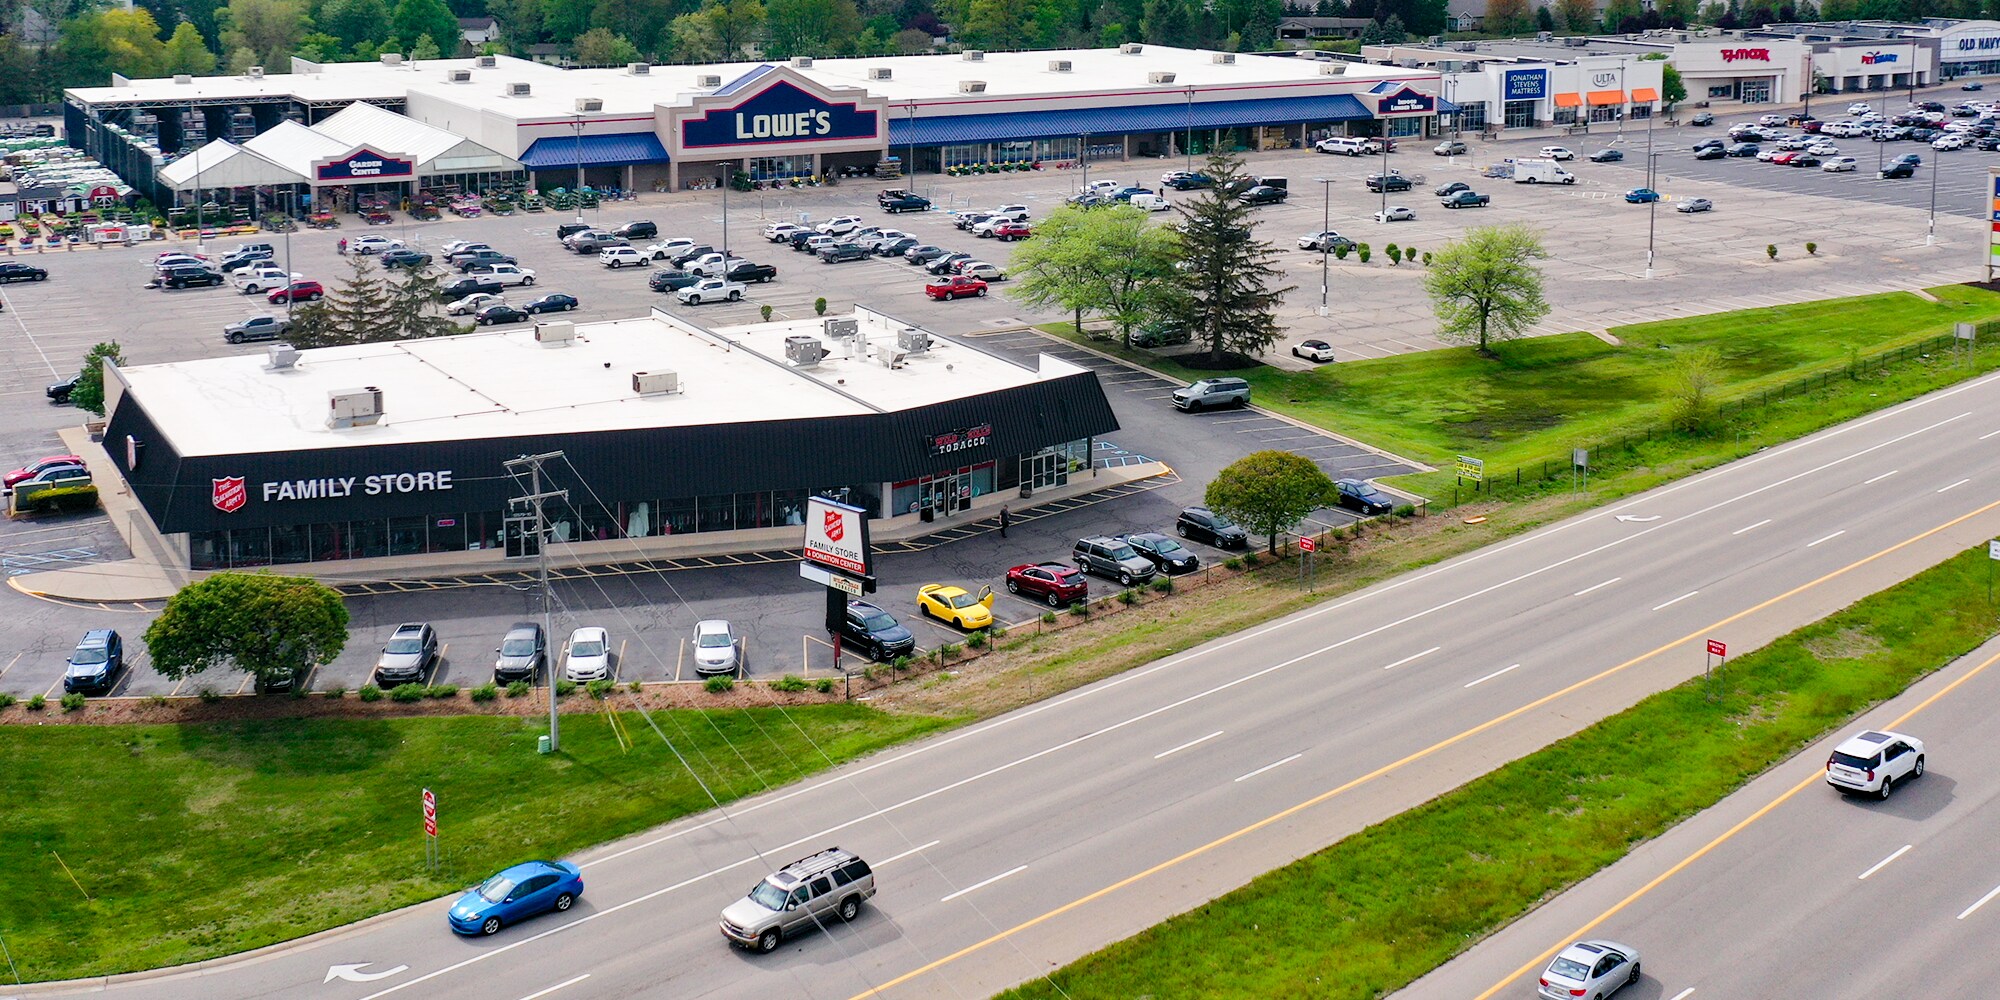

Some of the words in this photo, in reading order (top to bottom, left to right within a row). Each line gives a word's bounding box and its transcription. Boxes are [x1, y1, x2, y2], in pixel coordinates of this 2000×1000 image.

[1959, 38, 1975, 51] OLD
[1978, 37, 2000, 50] NAVY
[1509, 73, 1544, 82] JONATHAN
[1595, 73, 1616, 83] ULTA
[1513, 80, 1540, 88] STEVENS
[1511, 86, 1541, 95] MATTRESS
[736, 109, 831, 140] LOWE'S
[348, 160, 383, 169] GARDEN
[350, 168, 381, 176] CENTER
[935, 434, 958, 446] WILD
[939, 436, 986, 454] TOBACCO
[218, 480, 232, 492] THE
[263, 477, 356, 501] FAMILY
[364, 470, 453, 496] STORE
[224, 492, 243, 509] ARMY
[826, 513, 836, 523] THE
[830, 526, 842, 539] ARMY
[809, 540, 834, 553] FAMILY
[834, 546, 859, 561] STORE
[806, 549, 812, 557] &
[811, 550, 840, 565] DONATION
[839, 559, 862, 571] CENTER
[1708, 641, 1724, 650] WRONG
